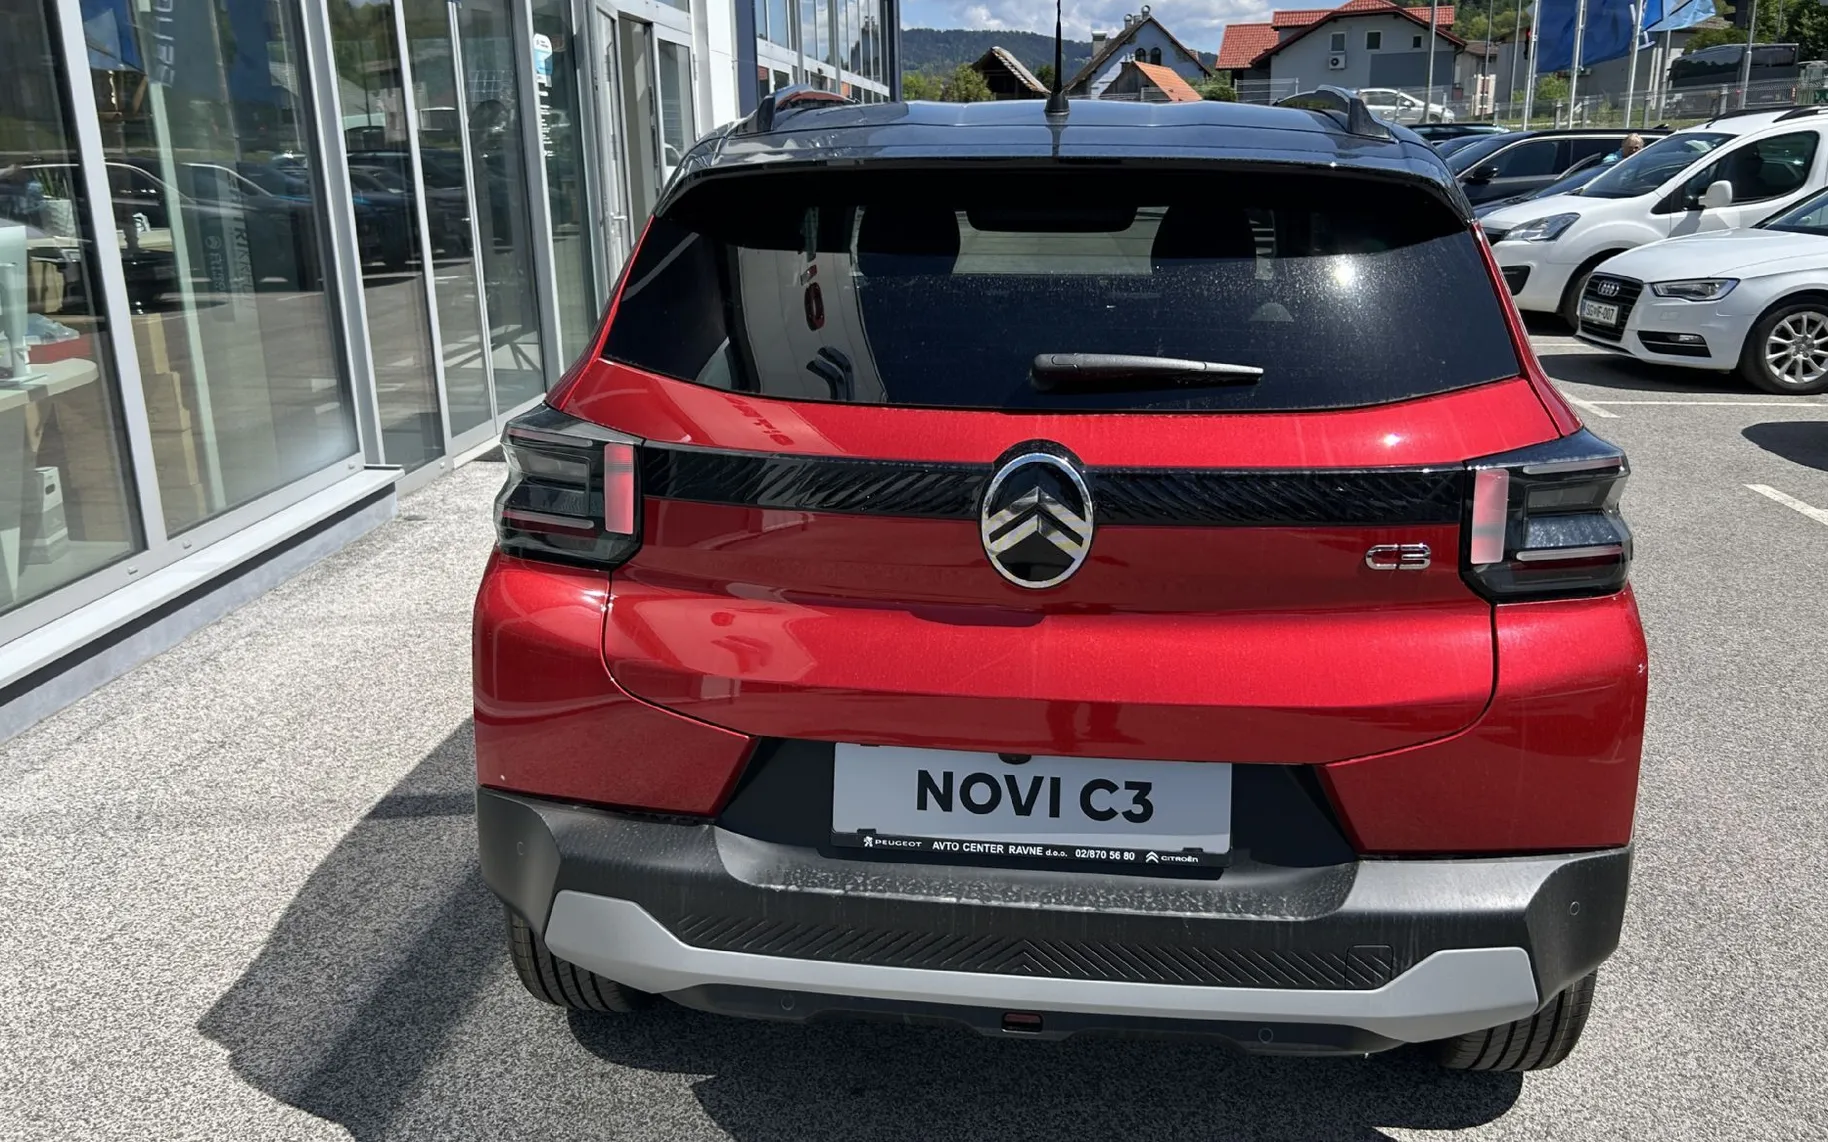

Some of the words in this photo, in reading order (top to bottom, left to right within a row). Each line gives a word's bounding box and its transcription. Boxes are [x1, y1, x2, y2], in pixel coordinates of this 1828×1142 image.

[1365, 543, 1431, 570] C3
[916, 769, 1061, 818] NOVI
[1079, 778, 1155, 824] C3
[875, 839, 923, 847] PEUGEOT
[932, 841, 960, 851] AVTO
[962, 842, 1004, 854] CENTER
[1008, 845, 1043, 856] RAVNE
[1045, 849, 1068, 858] d.o.o.
[1075, 849, 1107, 860] 02/870
[1109, 850, 1121, 860] 56
[1123, 851, 1136, 861] 80
